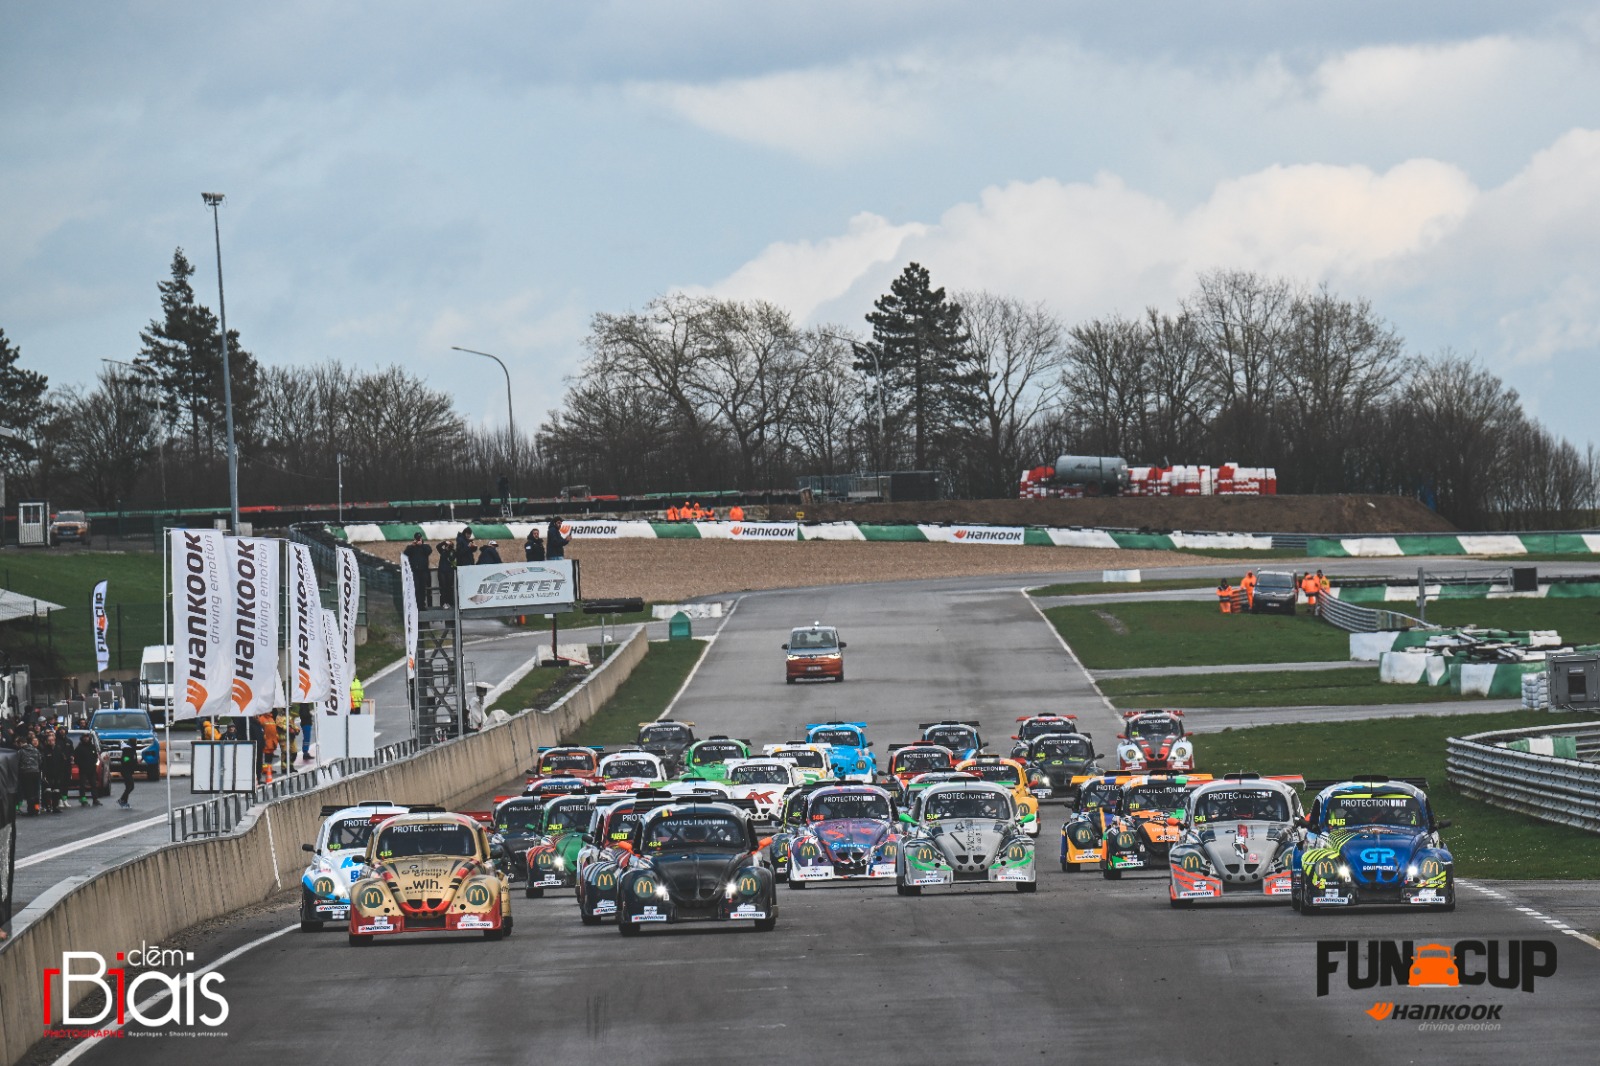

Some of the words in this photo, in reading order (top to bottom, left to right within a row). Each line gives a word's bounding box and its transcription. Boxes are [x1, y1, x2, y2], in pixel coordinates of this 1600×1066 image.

[205, 535, 220, 592] emotion
[258, 543, 268, 597] emotion
[477, 579, 567, 595] METTET
[206, 595, 222, 645] driving
[257, 599, 271, 647] driving
[1341, 799, 1389, 807] PROTECTION
[1360, 848, 1395, 863] GP
